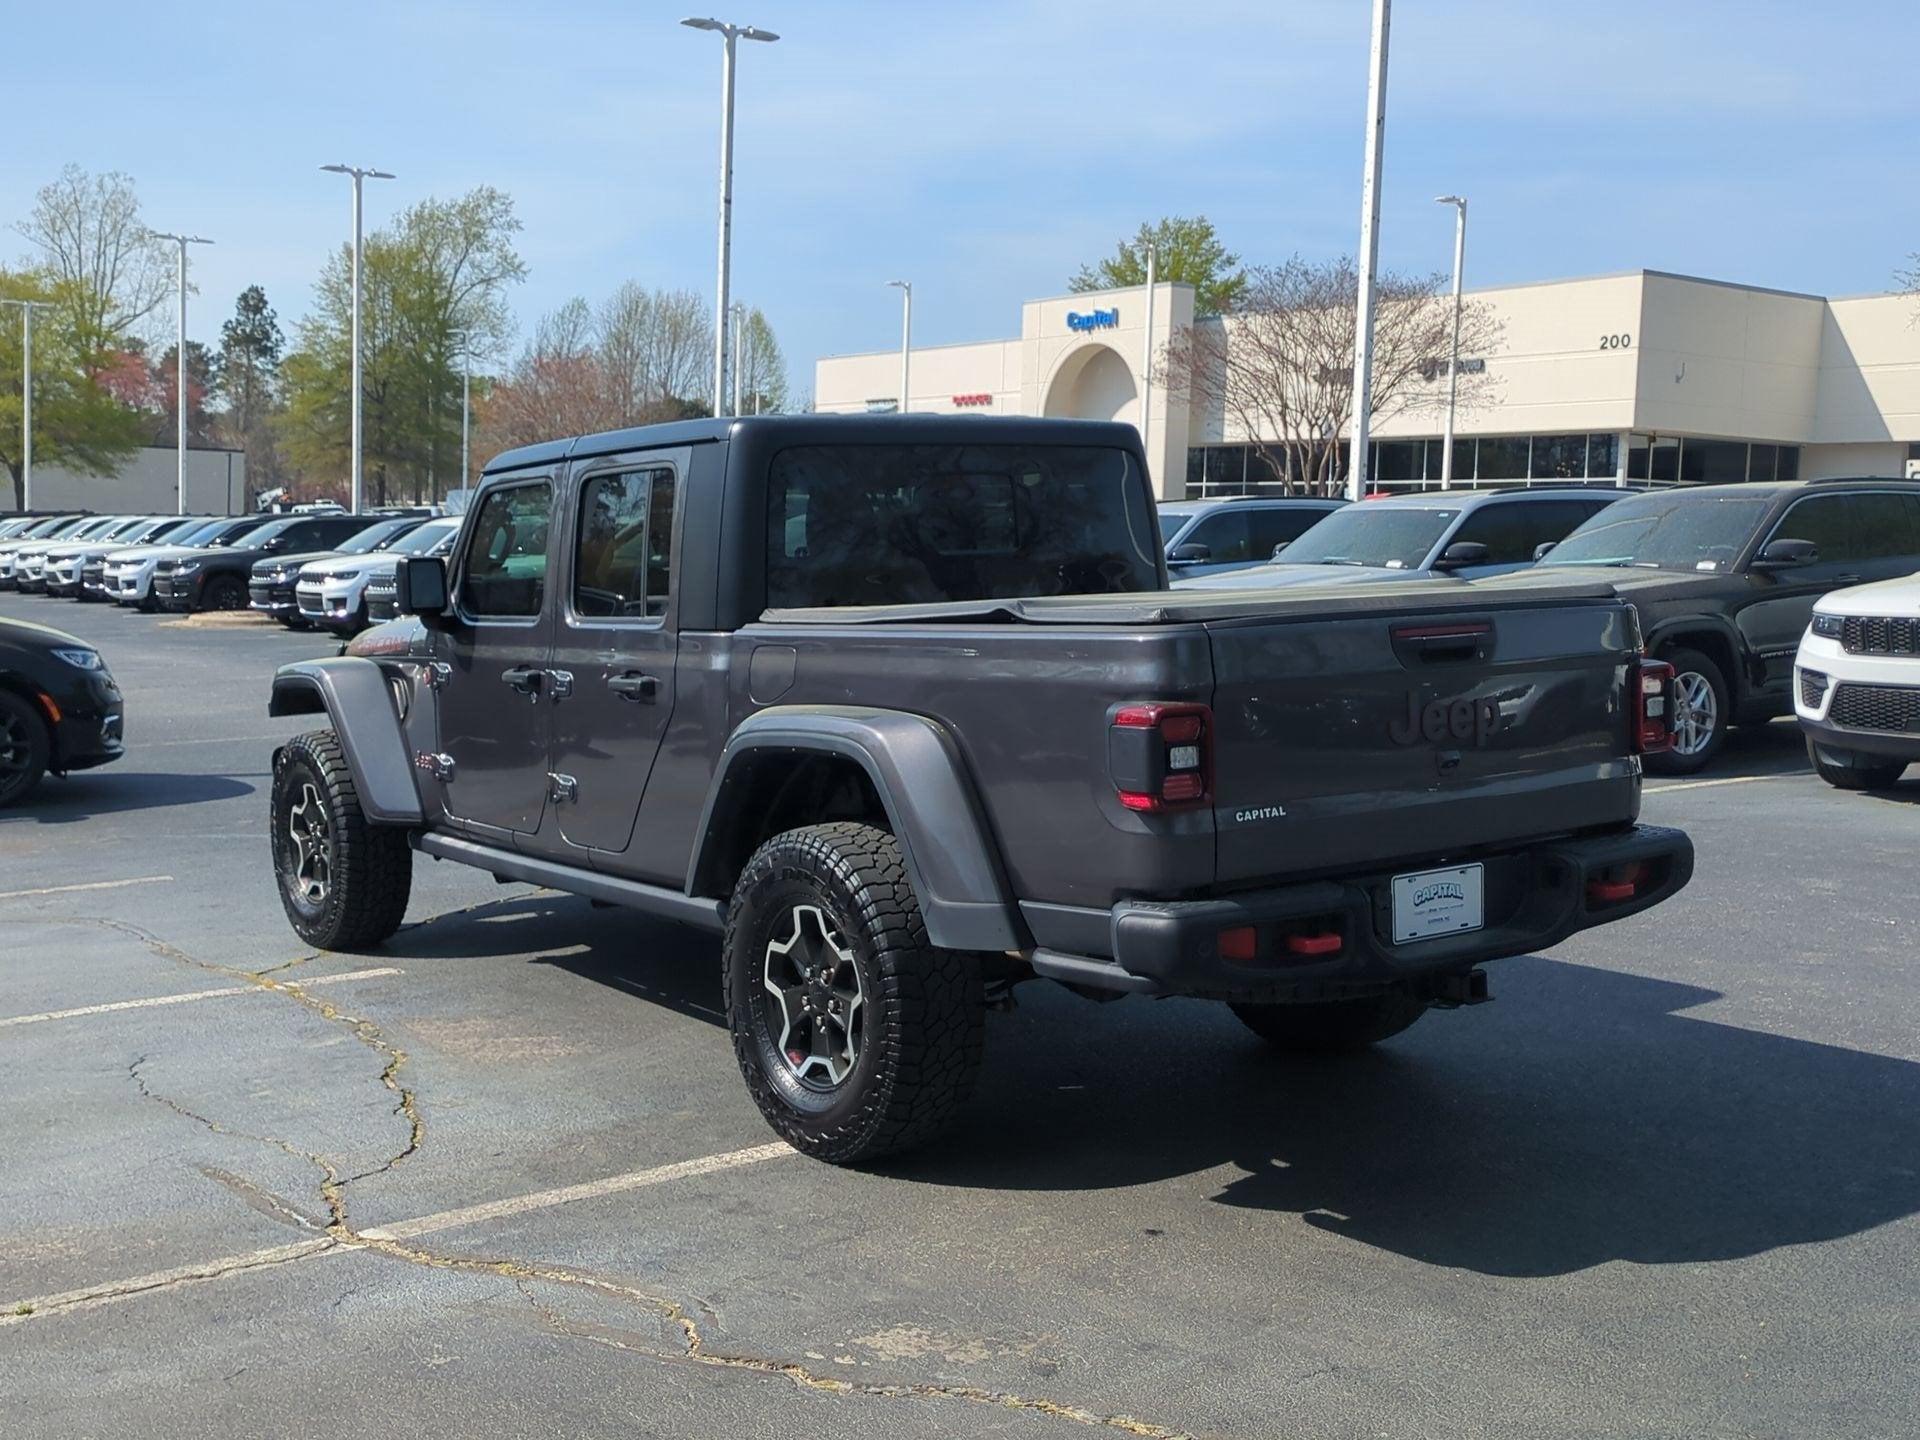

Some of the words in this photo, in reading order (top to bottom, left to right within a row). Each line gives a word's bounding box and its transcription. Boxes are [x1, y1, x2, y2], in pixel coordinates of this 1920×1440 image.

[1600, 334, 1631, 350] 200
[1387, 690, 1501, 747] Jeep
[1235, 805, 1287, 822] CAPITAL
[1413, 882, 1464, 907] CAPITAL
